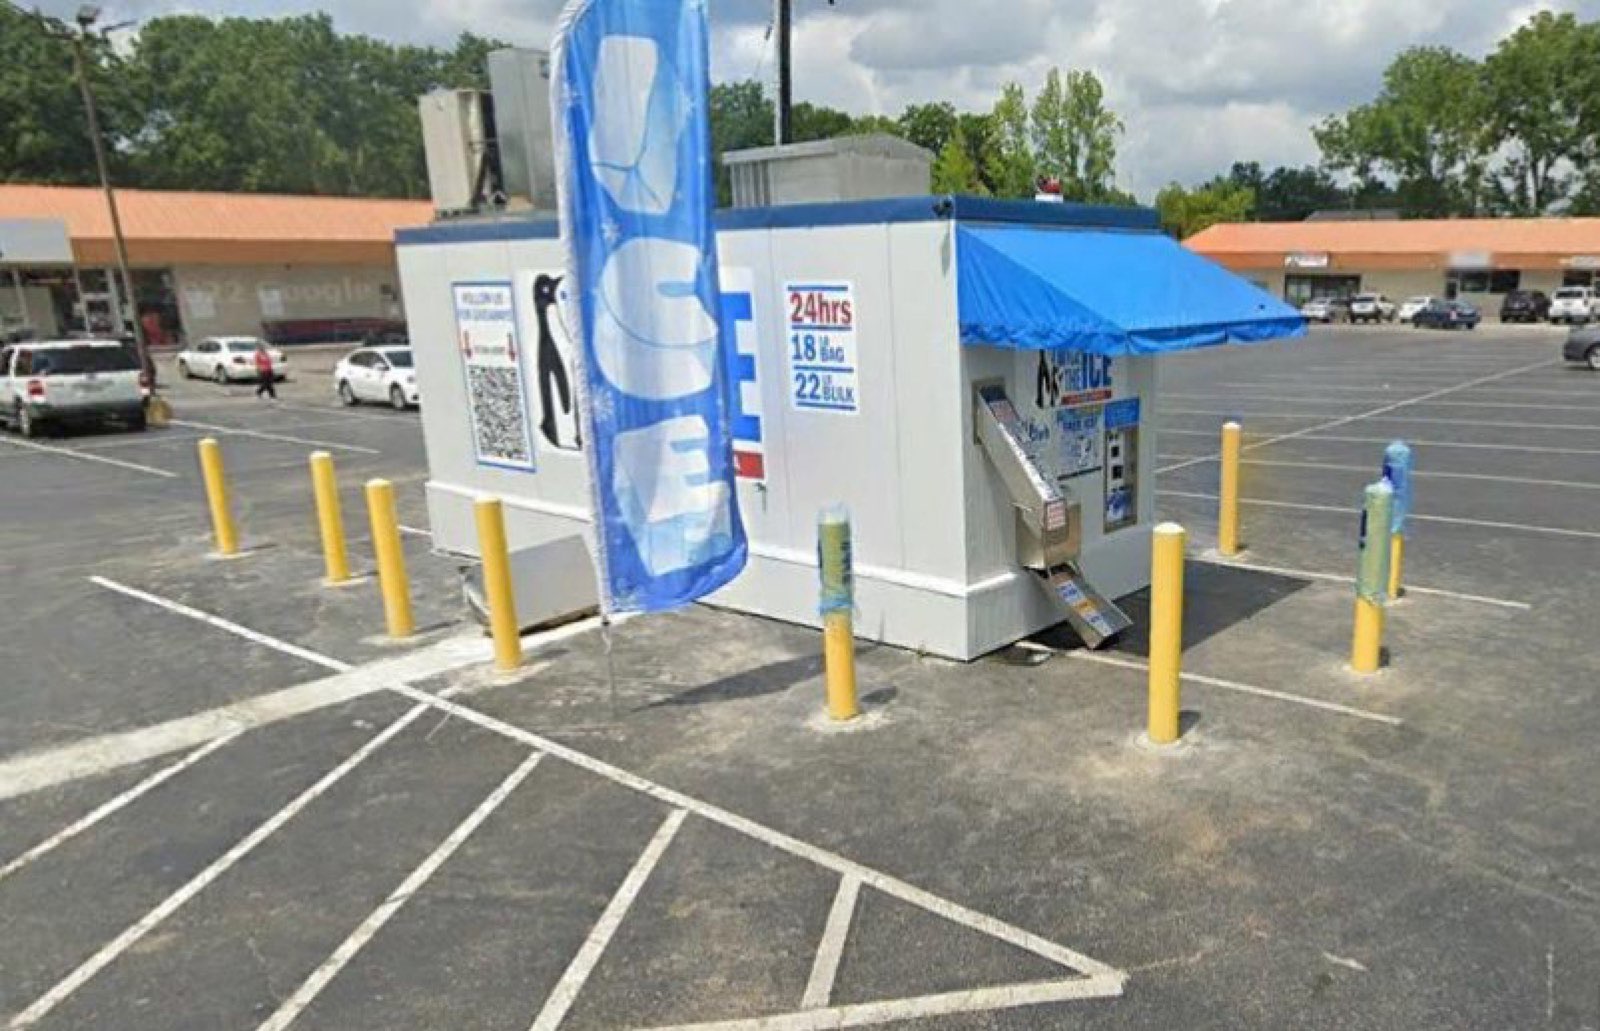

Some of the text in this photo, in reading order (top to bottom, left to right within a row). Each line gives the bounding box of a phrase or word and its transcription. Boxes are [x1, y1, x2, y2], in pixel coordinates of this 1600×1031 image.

[790, 291, 852, 325] 24hrs
[791, 333, 817, 361] 18
[795, 371, 821, 400] 22
[1082, 350, 1113, 390] ICE
